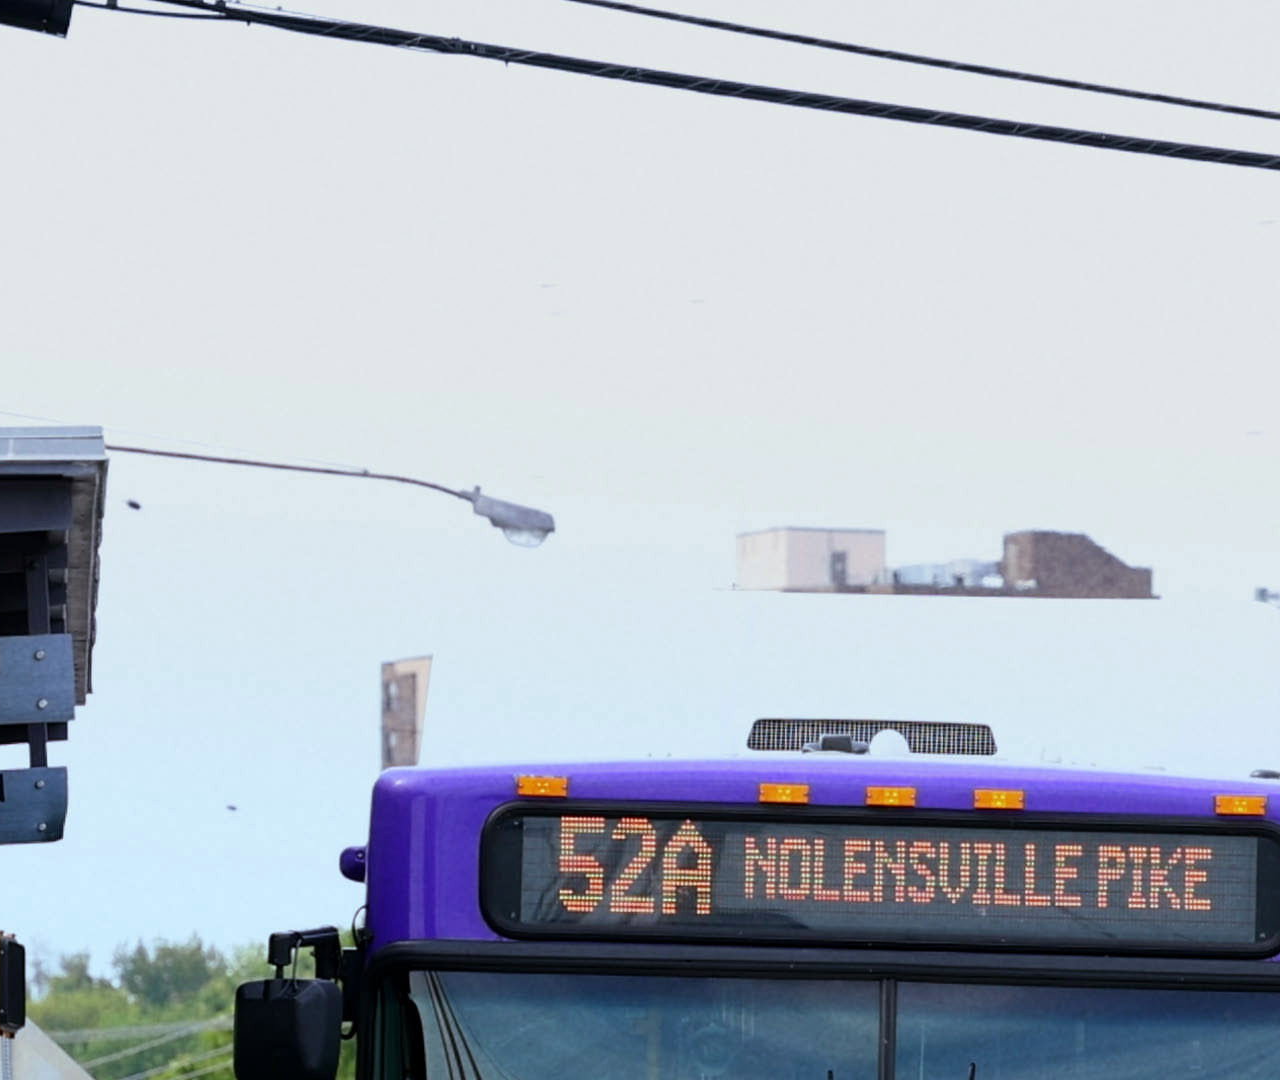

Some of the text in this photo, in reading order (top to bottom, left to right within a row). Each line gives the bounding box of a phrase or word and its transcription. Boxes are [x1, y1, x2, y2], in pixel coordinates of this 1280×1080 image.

[558, 816, 1212, 915] 52A NOLENSVILLE PIKE
